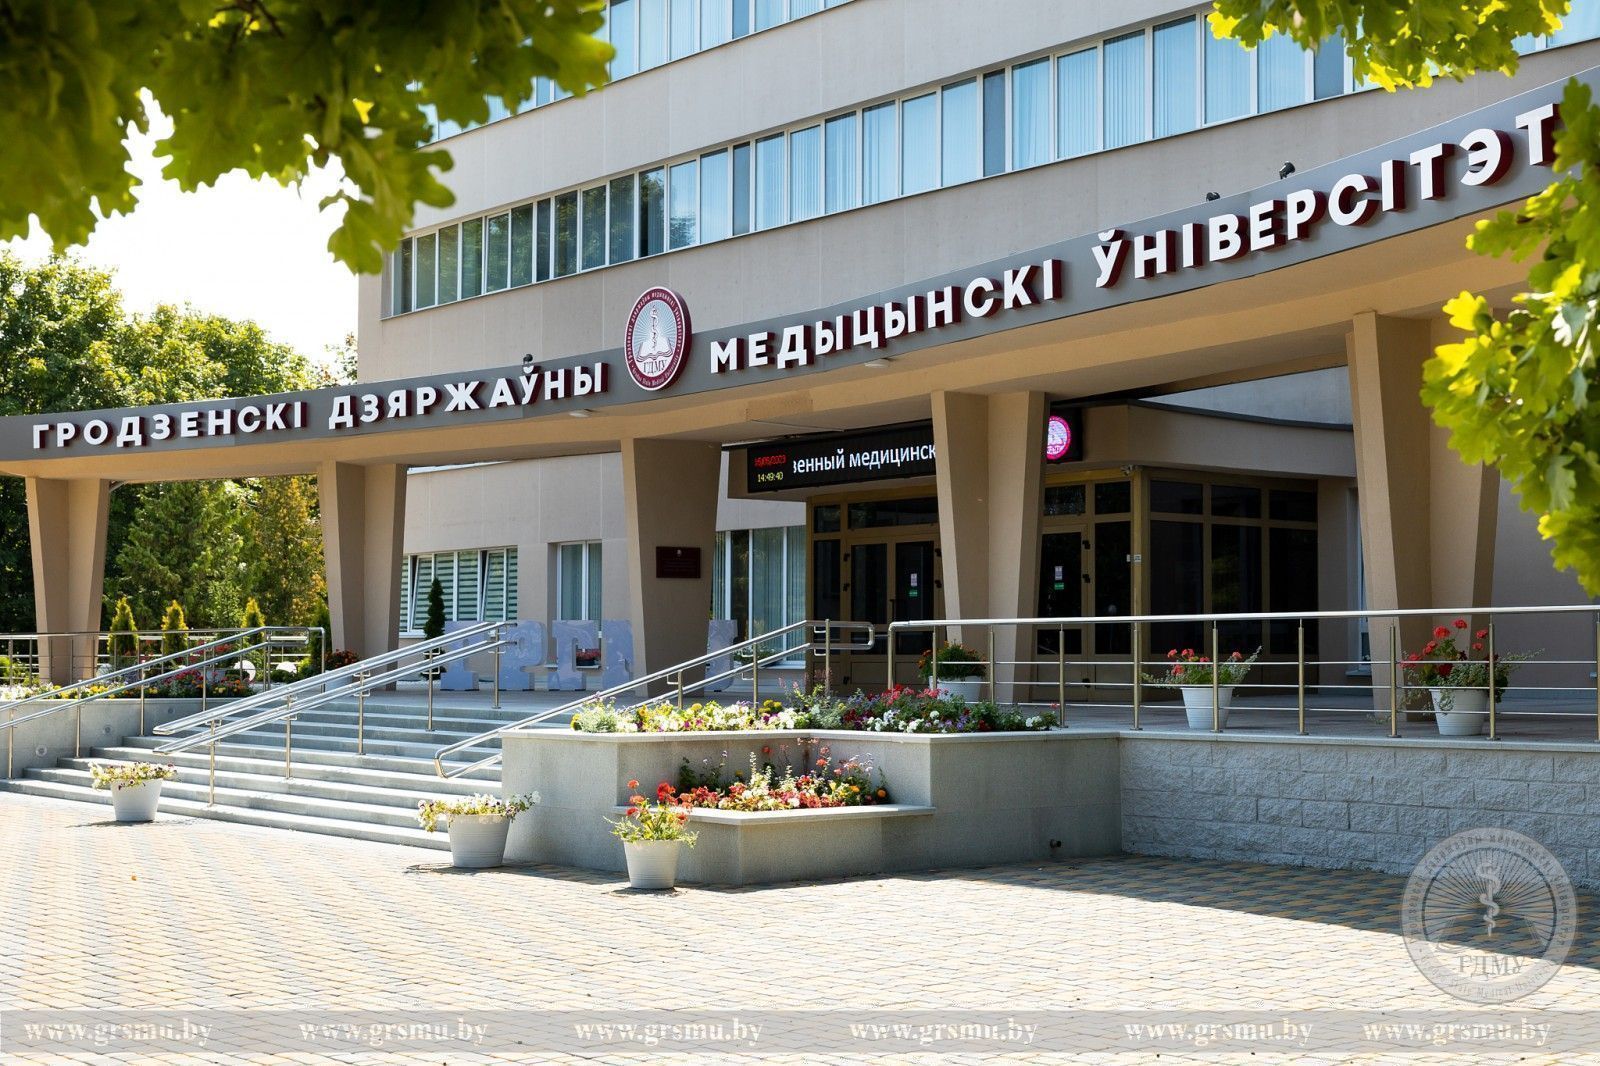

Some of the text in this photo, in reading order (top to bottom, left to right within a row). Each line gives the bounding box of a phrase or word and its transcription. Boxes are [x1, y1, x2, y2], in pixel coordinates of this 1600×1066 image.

[32, 401, 306, 449] ГРОДЗЕНСКІ
[328, 361, 608, 430] ДЗЯРЖАЎНЫ
[710, 259, 1061, 374] МЕДЫЦЫНСКІ
[1091, 103, 1559, 288] ЎНІВЕРСІТЭТ
[849, 444, 937, 470] медицинск
